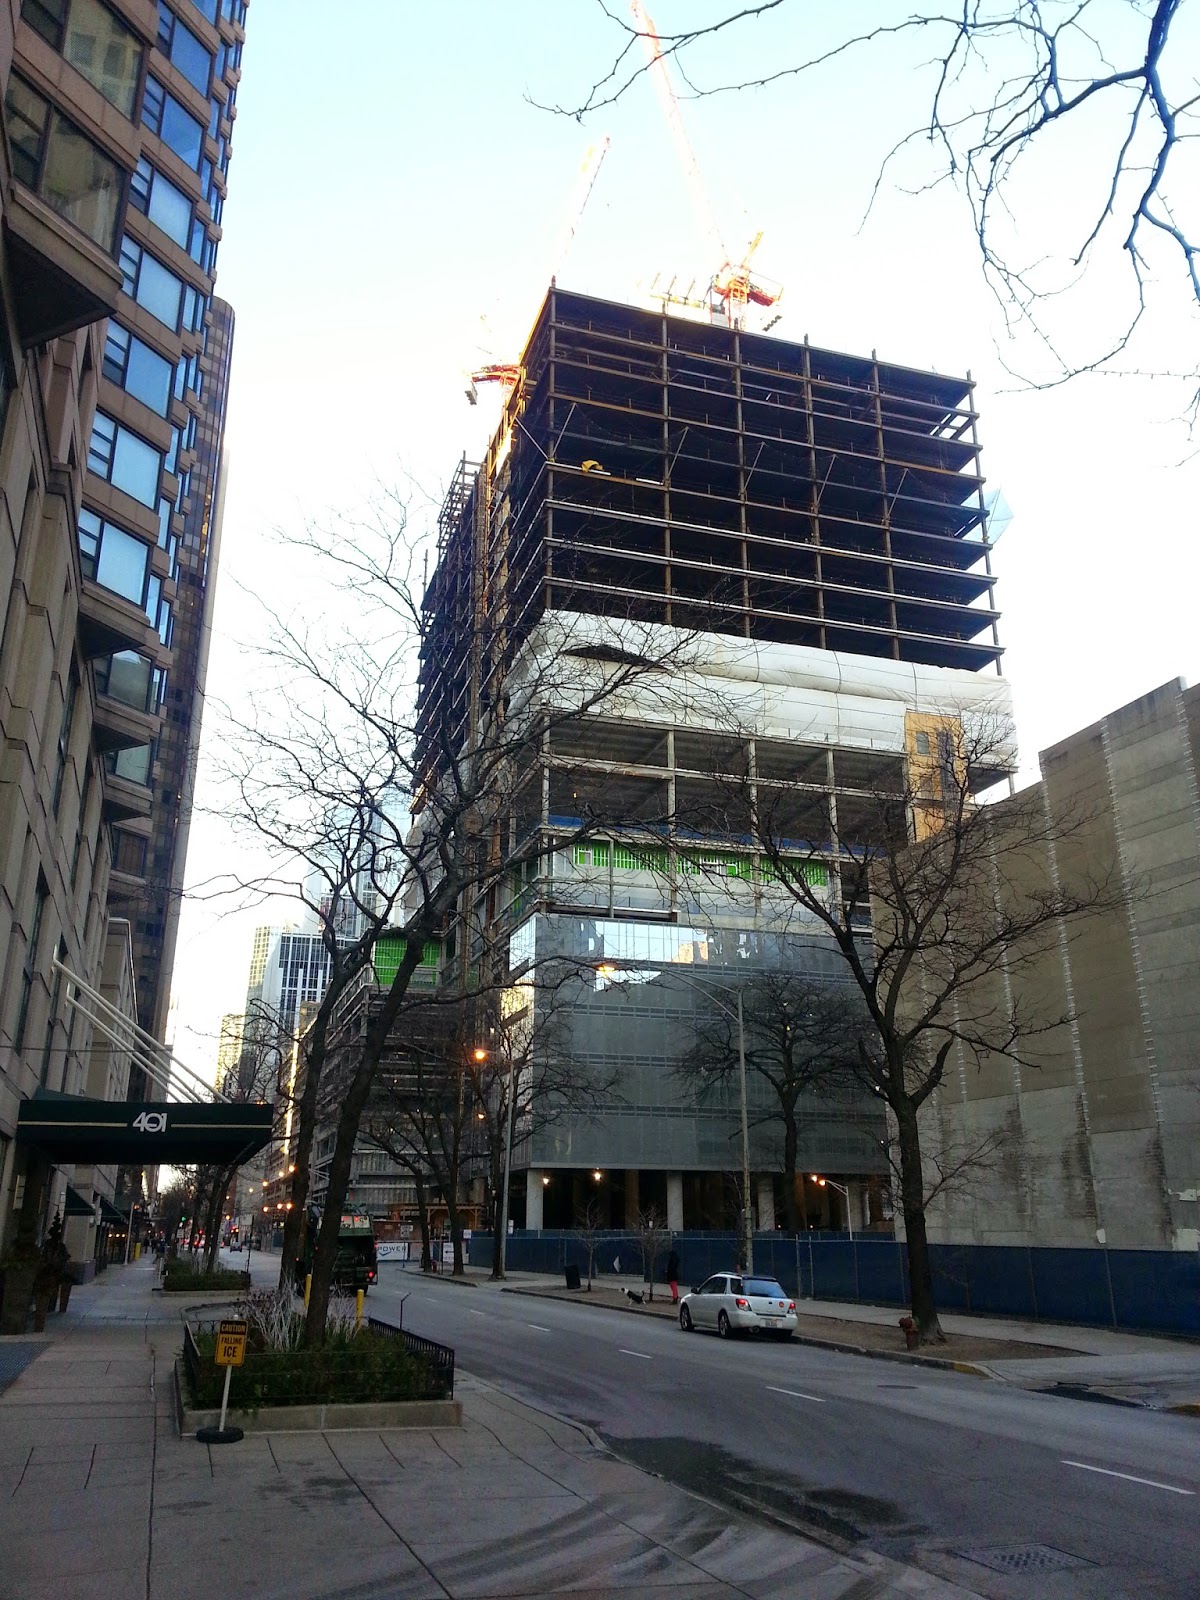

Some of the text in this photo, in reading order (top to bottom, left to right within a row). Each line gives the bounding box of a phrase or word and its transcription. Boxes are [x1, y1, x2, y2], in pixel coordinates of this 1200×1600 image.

[132, 1111, 168, 1133] 401
[221, 1324, 246, 1333] CAUTION
[221, 1336, 242, 1345] FALLING
[223, 1346, 238, 1357] ICE
